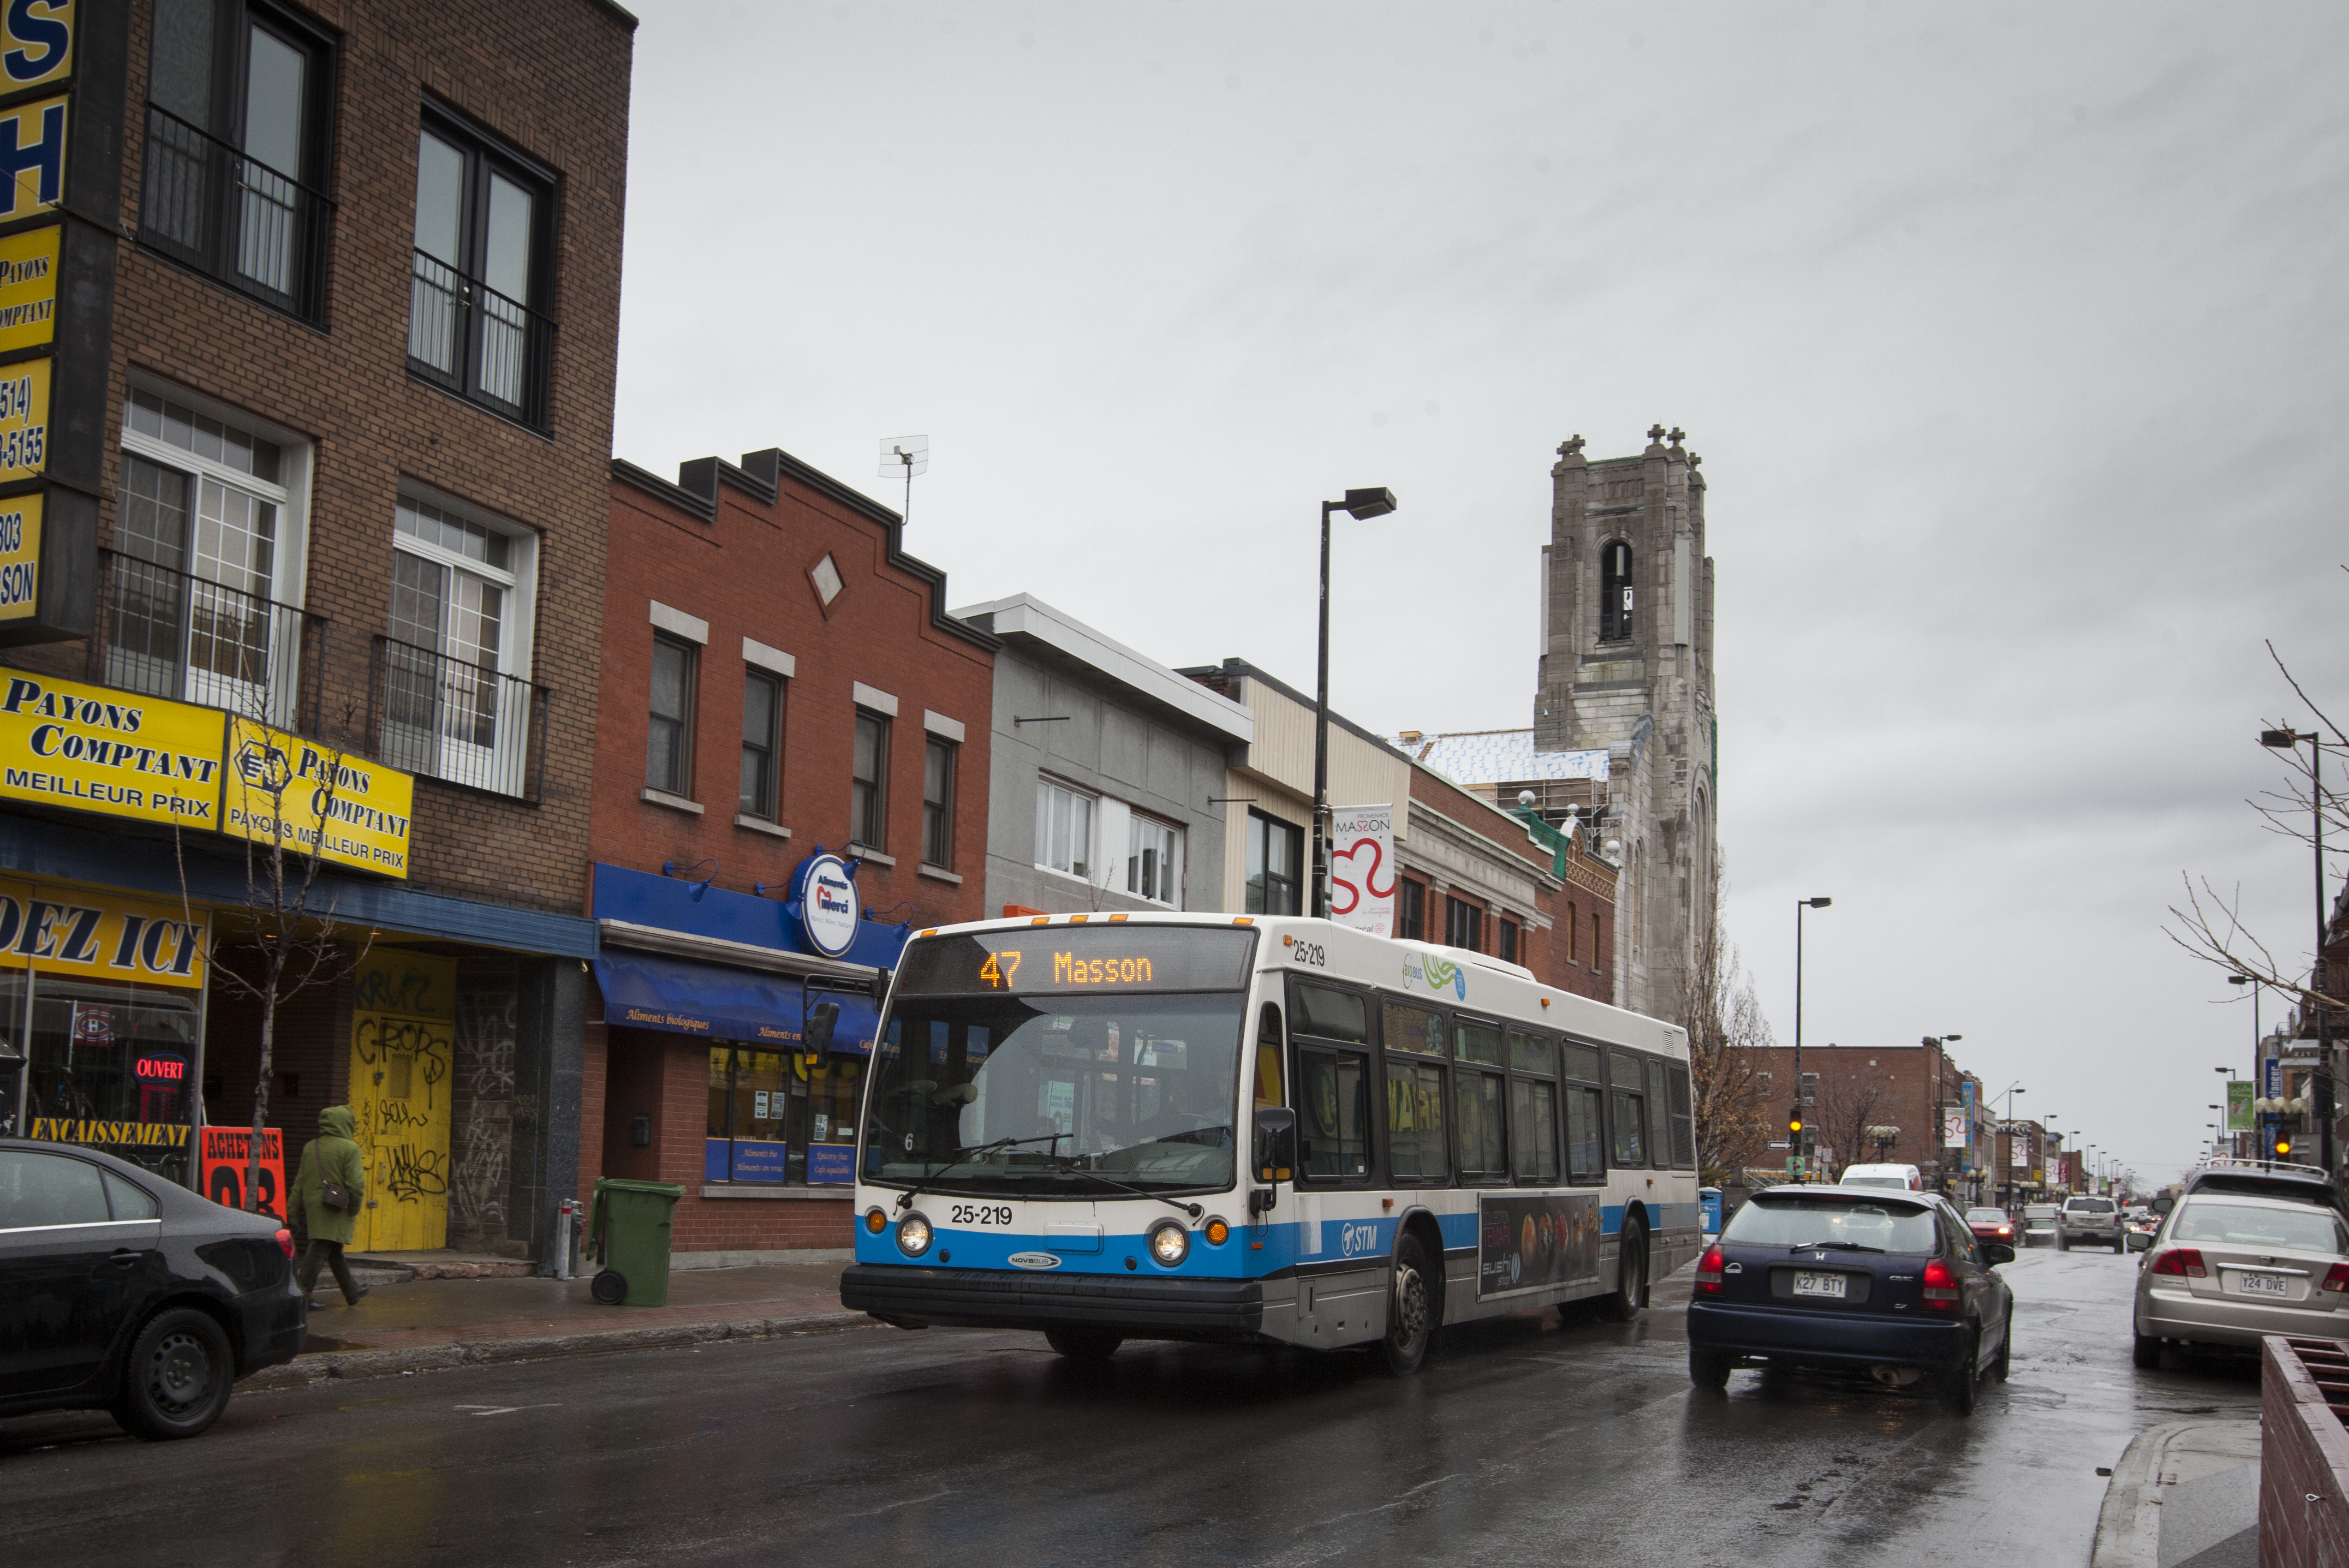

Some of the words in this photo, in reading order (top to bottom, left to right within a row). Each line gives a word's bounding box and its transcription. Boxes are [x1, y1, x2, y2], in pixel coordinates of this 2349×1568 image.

[0, 375, 32, 426] 514)
[0, 561, 35, 606] SON
[1, 677, 142, 734] PAYONS
[29, 723, 218, 784] COMPTANT
[5, 767, 144, 808] MEILLEUR
[151, 793, 211, 819] PRIX
[310, 786, 409, 838] COMPTANT
[372, 847, 404, 869] PRIX
[109, 913, 204, 976] ICI
[1293, 939, 1325, 967] 25-219
[981, 951, 1021, 987] 47
[1054, 951, 1152, 983] Masson
[626, 1009, 665, 1024] Aliments
[666, 1013, 710, 1031] biologiques
[758, 1027, 791, 1040] Aliments
[136, 1059, 184, 1079] OUVERT
[31, 1117, 191, 1147] ENCAISSEMENT
[905, 1133, 914, 1151] 6
[207, 1132, 279, 1160] ACHETNS
[951, 1205, 1012, 1225] 25-219
[1355, 1225, 1376, 1252] STM
[1483, 1253, 1511, 1275] sushi
[1498, 1274, 1511, 1287] shop
[1795, 1276, 1818, 1290] K27
[1822, 1278, 1845, 1293] BTY
[2243, 1277, 2261, 1289] Y24
